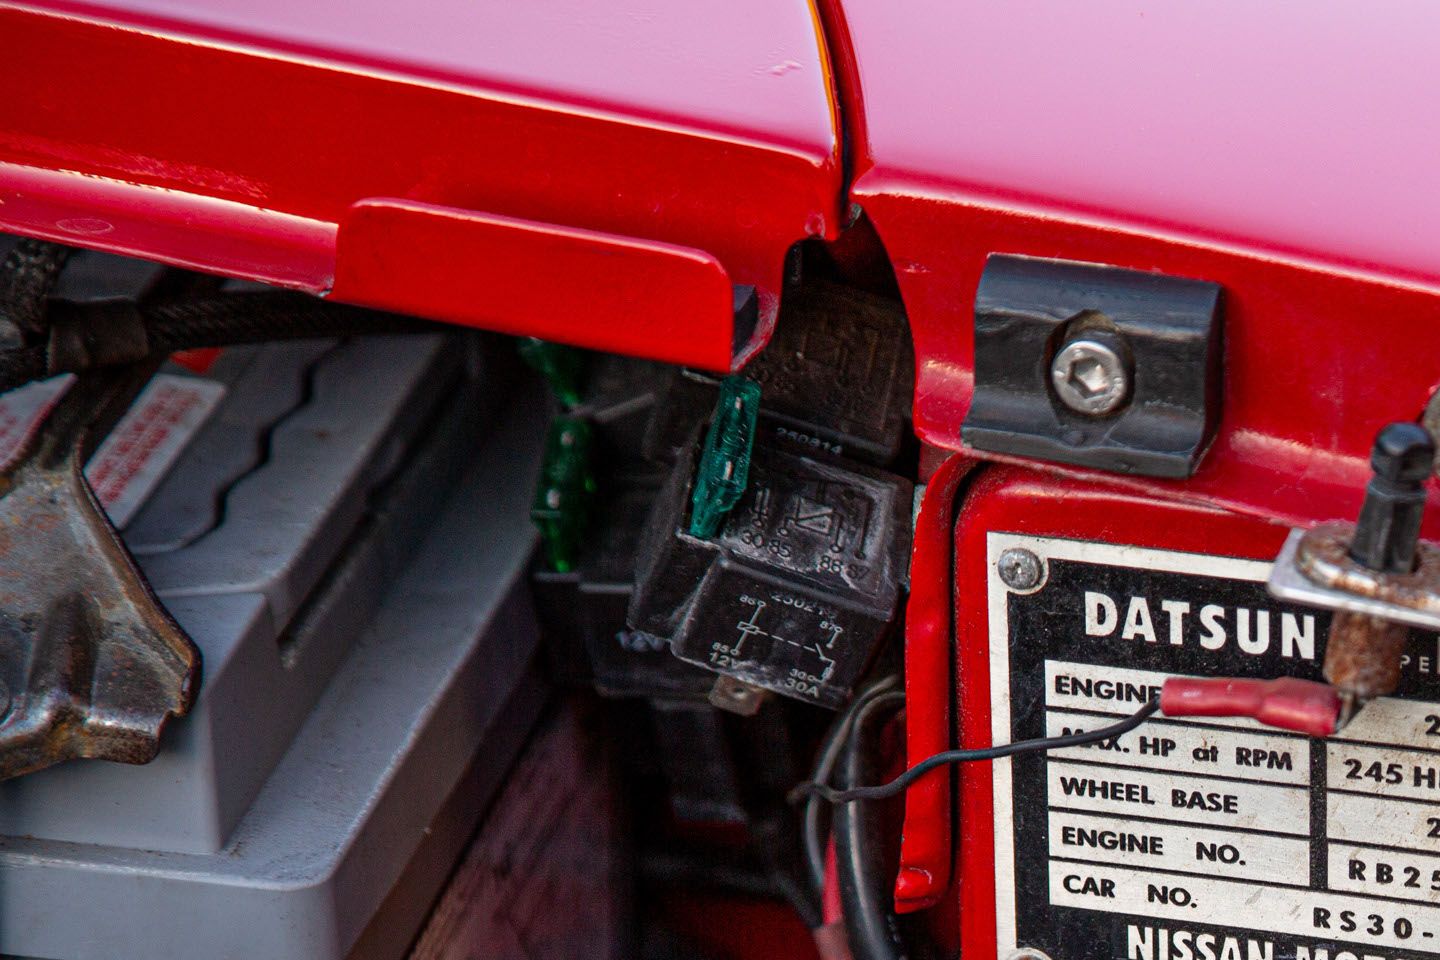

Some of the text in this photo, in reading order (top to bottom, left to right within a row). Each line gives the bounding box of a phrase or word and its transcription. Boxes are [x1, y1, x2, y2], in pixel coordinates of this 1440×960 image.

[1084, 591, 1316, 660] DATSUN
[1139, 736, 1176, 757] HP
[1192, 745, 1219, 763] at
[1235, 746, 1293, 771] RPM
[1343, 758, 1404, 785] 245
[1060, 776, 1239, 814] WHEEL BASE
[1061, 825, 1246, 866] ENGINE NO.
[1062, 874, 1198, 909] CAR NO.
